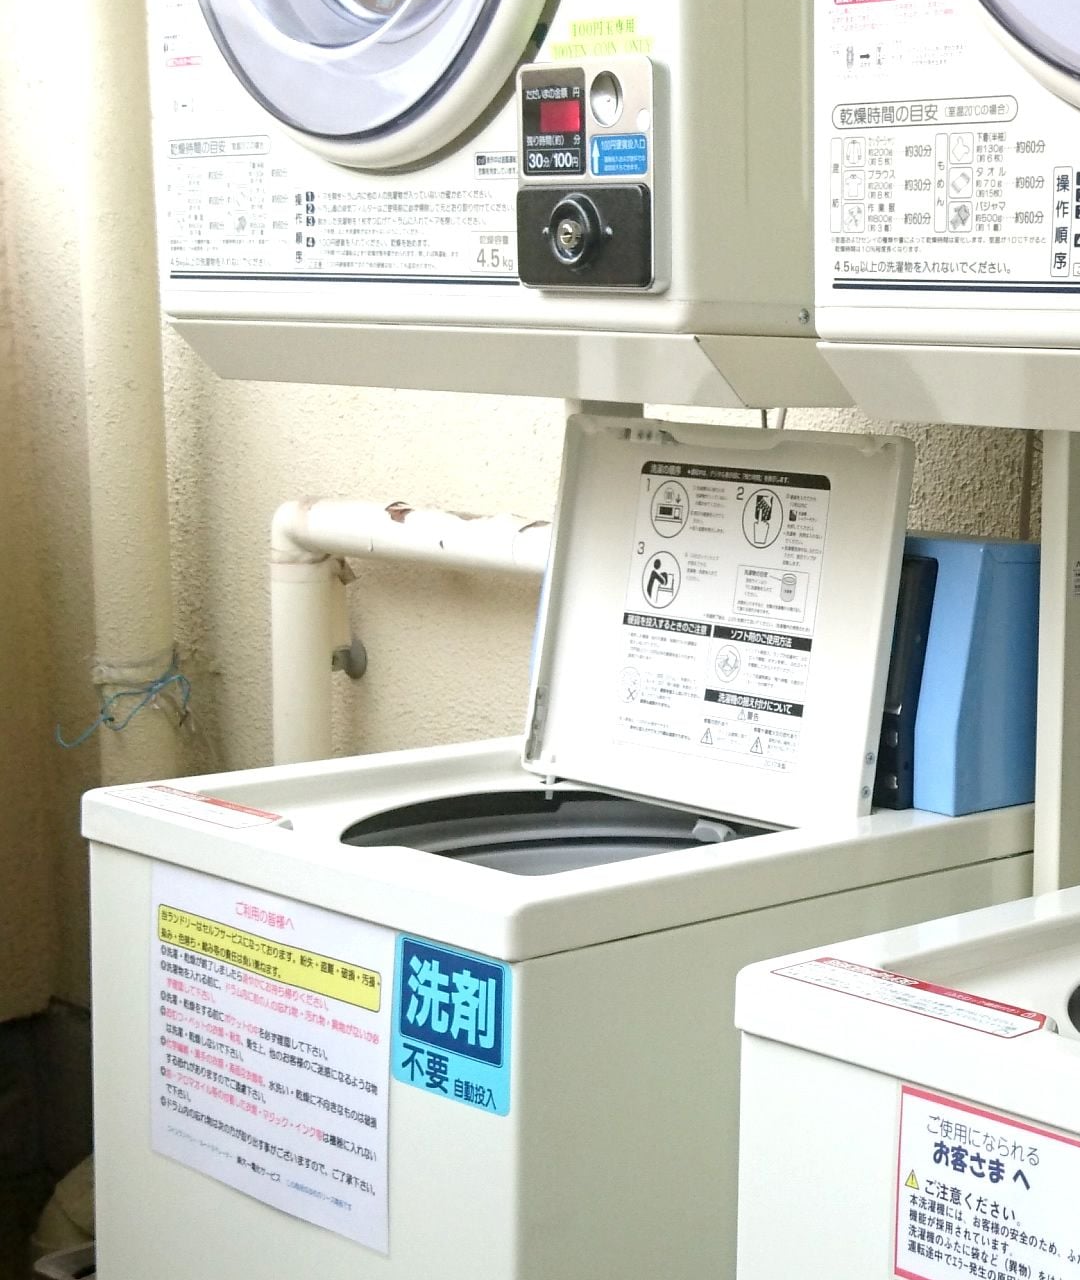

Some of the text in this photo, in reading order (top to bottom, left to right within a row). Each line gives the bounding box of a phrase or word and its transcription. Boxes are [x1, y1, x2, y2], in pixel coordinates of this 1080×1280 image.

[573, 87, 580, 98] 円
[840, 105, 938, 125] 乾燥時間の目安
[573, 135, 580, 145] 分
[905, 145, 932, 157] 約30分
[1016, 141, 1046, 154] 約60分
[905, 179, 932, 192] 約30分
[1016, 177, 1045, 189] 約60分
[904, 212, 931, 225] 約60分
[1015, 211, 1044, 224] 約60分
[1054, 175, 1069, 270] 操作順序
[477, 249, 500, 268] 4.5
[502, 257, 513, 270] kg
[737, 487, 744, 500] 2
[637, 541, 645, 555] 3
[407, 954, 496, 1049] 洗剤
[402, 1043, 449, 1094] 不要
[453, 1079, 496, 1110] 自動投入
[926, 1115, 1040, 1166] ご使用になられる
[924, 1179, 1022, 1227] ご注意ください。
[909, 1209, 1013, 1258] 機能が採用されています。
